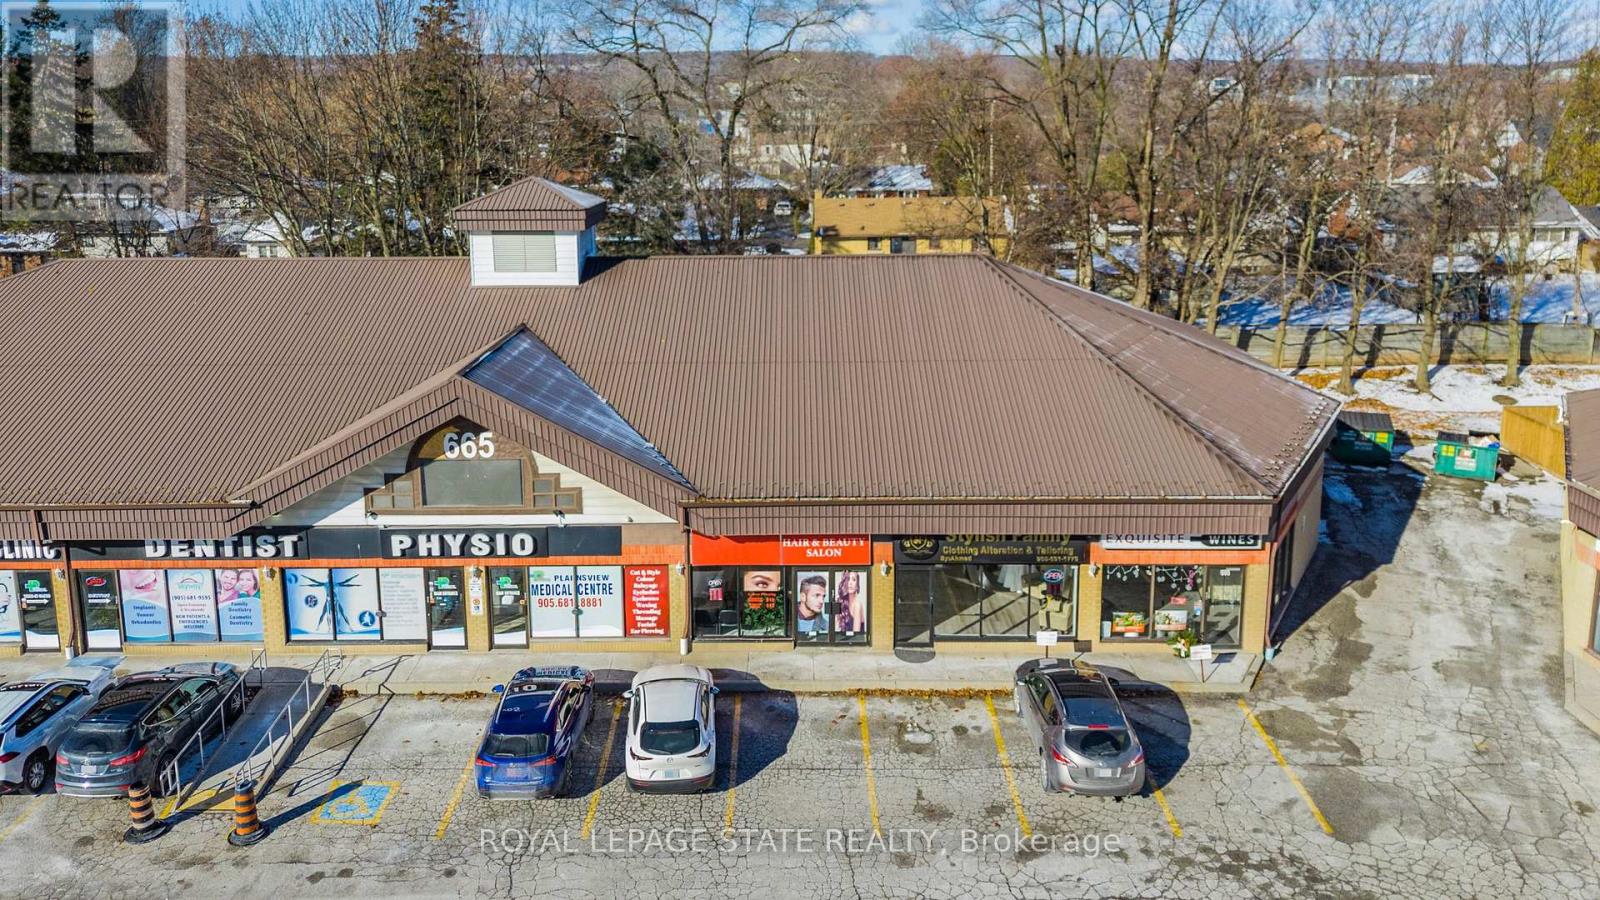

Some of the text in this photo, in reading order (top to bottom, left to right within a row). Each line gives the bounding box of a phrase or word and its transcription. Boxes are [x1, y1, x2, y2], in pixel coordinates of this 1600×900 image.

[443, 432, 496, 459] 665
[391, 533, 535, 557] PHYSIO
[783, 538, 866, 547] HAIR & BEAUTY
[1106, 533, 1255, 545] EXQUISITE WINES
[0, 540, 56, 559] LINIC
[145, 535, 299, 559] DENTIST
[806, 549, 842, 557] SALON
[942, 546, 978, 556] Clothing
[531, 583, 613, 596] MEDICAL CENTRE
[537, 598, 603, 608] 905.681.8881
